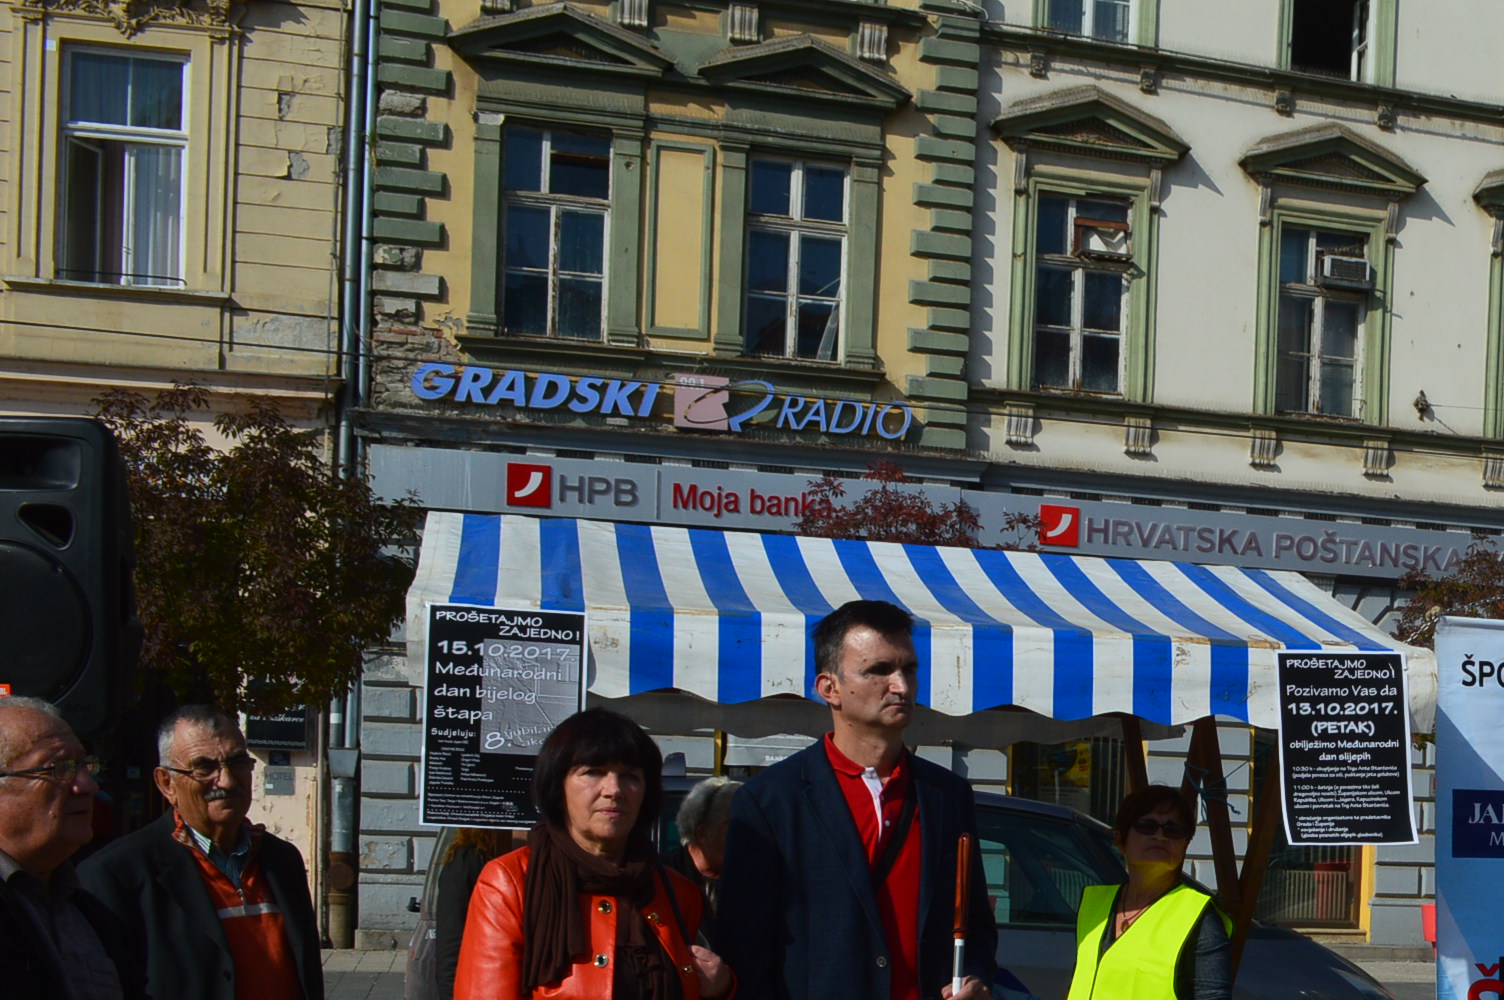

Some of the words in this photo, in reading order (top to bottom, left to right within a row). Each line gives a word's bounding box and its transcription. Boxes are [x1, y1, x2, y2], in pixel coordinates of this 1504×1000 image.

[410, 361, 660, 417] GRADSKI
[776, 395, 912, 440] RADIO
[558, 474, 638, 506] HPB
[672, 483, 740, 518] Moja
[1086, 516, 1260, 558] HRVATSKA
[1273, 531, 1462, 573] POŠTANSKA
[435, 611, 543, 627] PROŠETAJMO
[437, 640, 576, 661] 15.10.2017.
[1286, 657, 1366, 669] PROŠETAJMO
[435, 662, 563, 681] Međunarodni
[434, 683, 470, 698] dan
[475, 685, 536, 704] bijelog
[1286, 684, 1349, 697] Pozivamo
[1352, 685, 1377, 696] Vas
[1380, 684, 1397, 696] da
[433, 705, 493, 725] štapa
[1287, 702, 1398, 715] 13.10.2017.
[430, 727, 477, 739] Sudjeluju:
[1311, 720, 1375, 736] (PETAK)
[1290, 739, 1335, 751] obilježimo
[1338, 739, 1399, 749] Međunarodni
[1319, 752, 1337, 761] dan
[1338, 751, 1371, 763] slijepih
